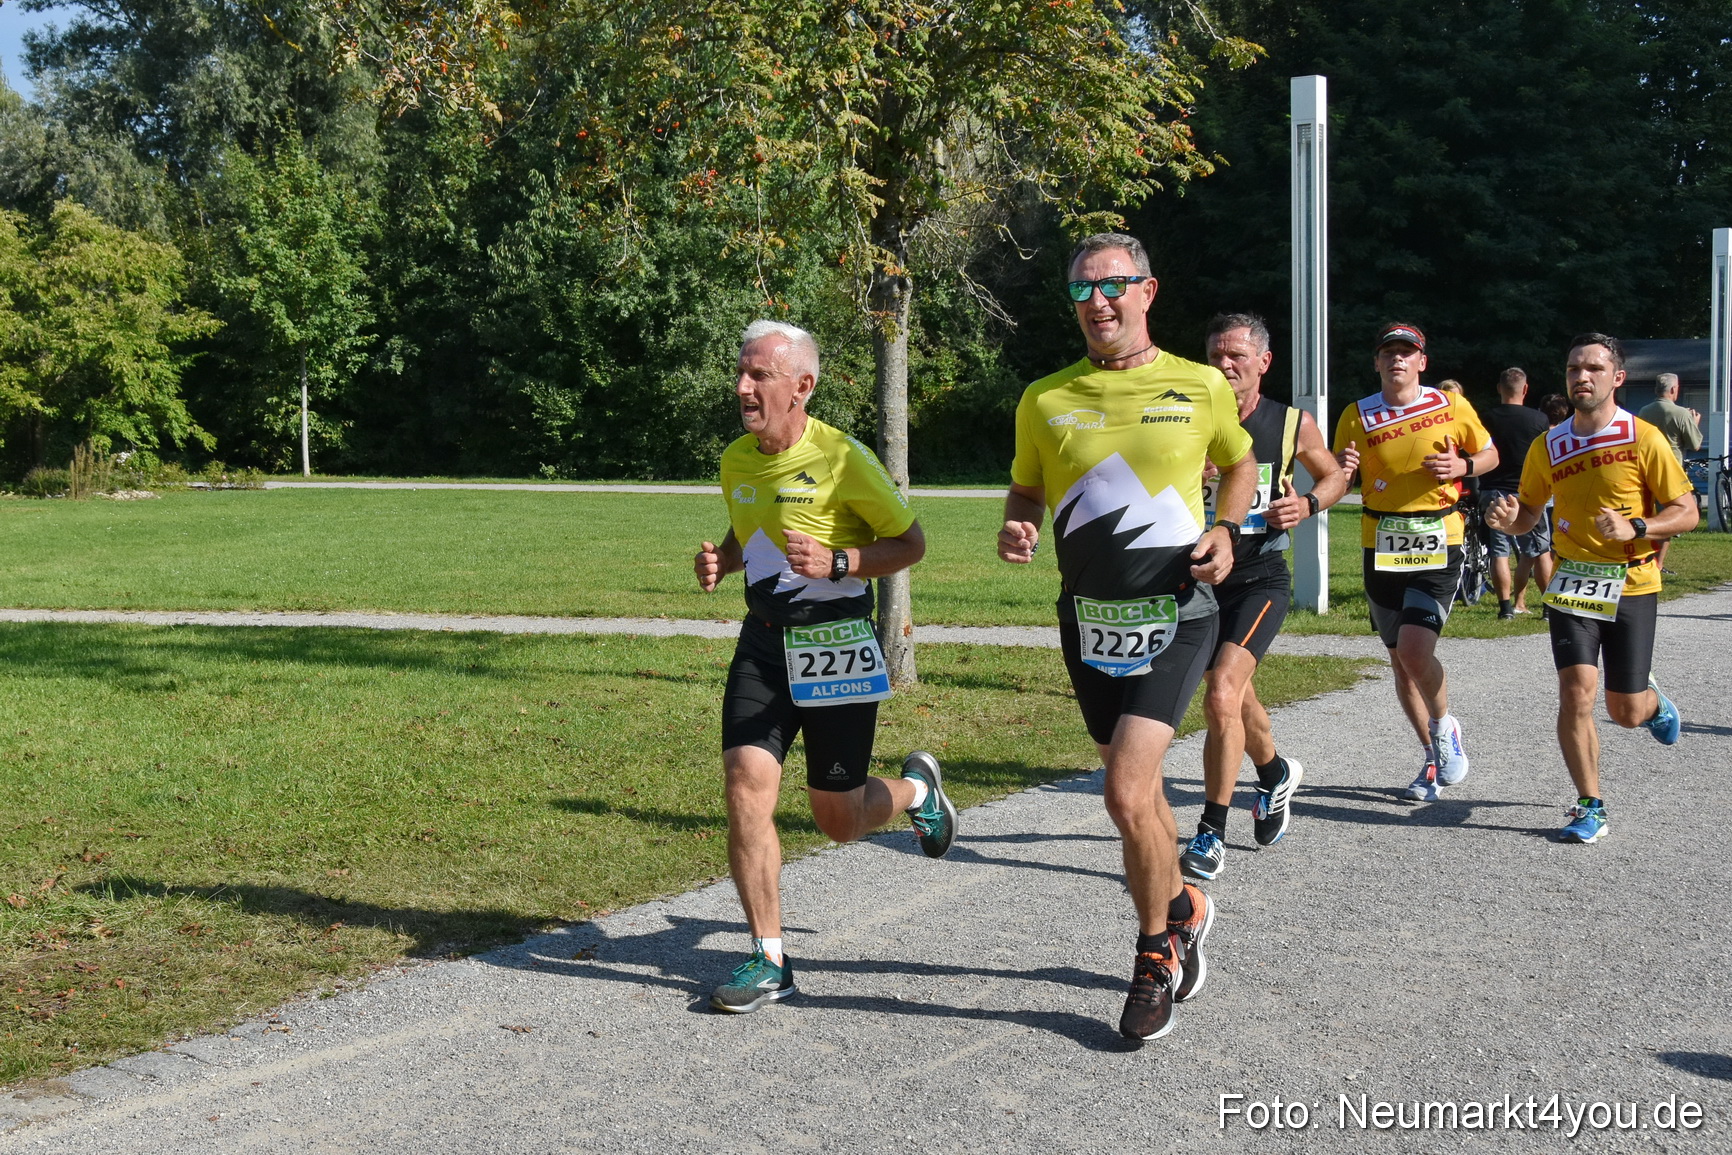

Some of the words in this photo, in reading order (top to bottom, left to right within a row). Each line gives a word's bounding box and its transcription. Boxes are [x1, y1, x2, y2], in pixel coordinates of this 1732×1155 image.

[1075, 421, 1105, 430] MARX
[1140, 415, 1191, 424] Runners
[1367, 427, 1406, 448] MAX
[1409, 412, 1454, 433] BÖGL
[1552, 460, 1587, 484] MAX
[1591, 450, 1639, 468] BÖGL
[774, 495, 814, 504] Runners
[1382, 517, 1440, 531] BOCK
[1385, 535, 1439, 551] 1243
[1393, 557, 1429, 565] SIMON
[1561, 560, 1621, 578] BOCK
[1558, 576, 1612, 598] 1131
[1082, 599, 1169, 623] BOCK
[1552, 595, 1604, 612] MATHIAS
[792, 619, 871, 645] BOCK
[1091, 628, 1166, 658] 2226
[799, 646, 876, 677] 2279
[811, 681, 872, 697] ALFONS
